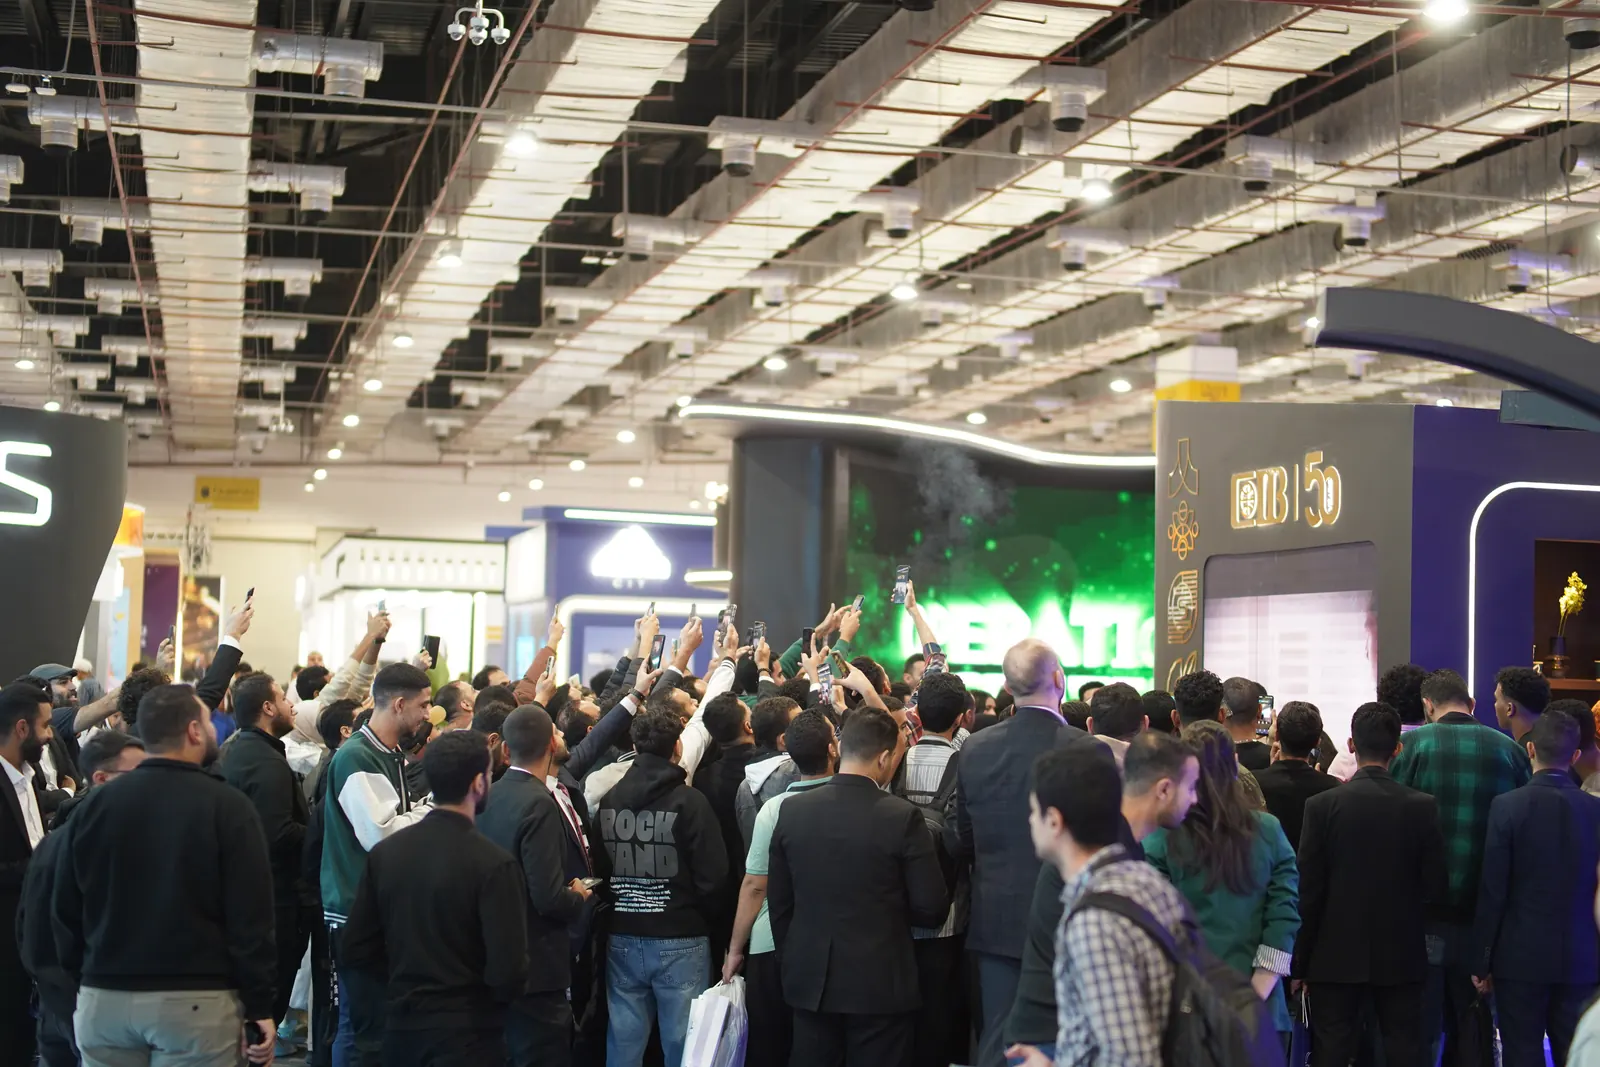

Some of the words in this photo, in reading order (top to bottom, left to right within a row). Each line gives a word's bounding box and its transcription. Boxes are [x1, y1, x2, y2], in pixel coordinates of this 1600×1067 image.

[0, 440, 52, 526] S
[1305, 451, 1341, 527] 50
[600, 808, 678, 843] ROCK
